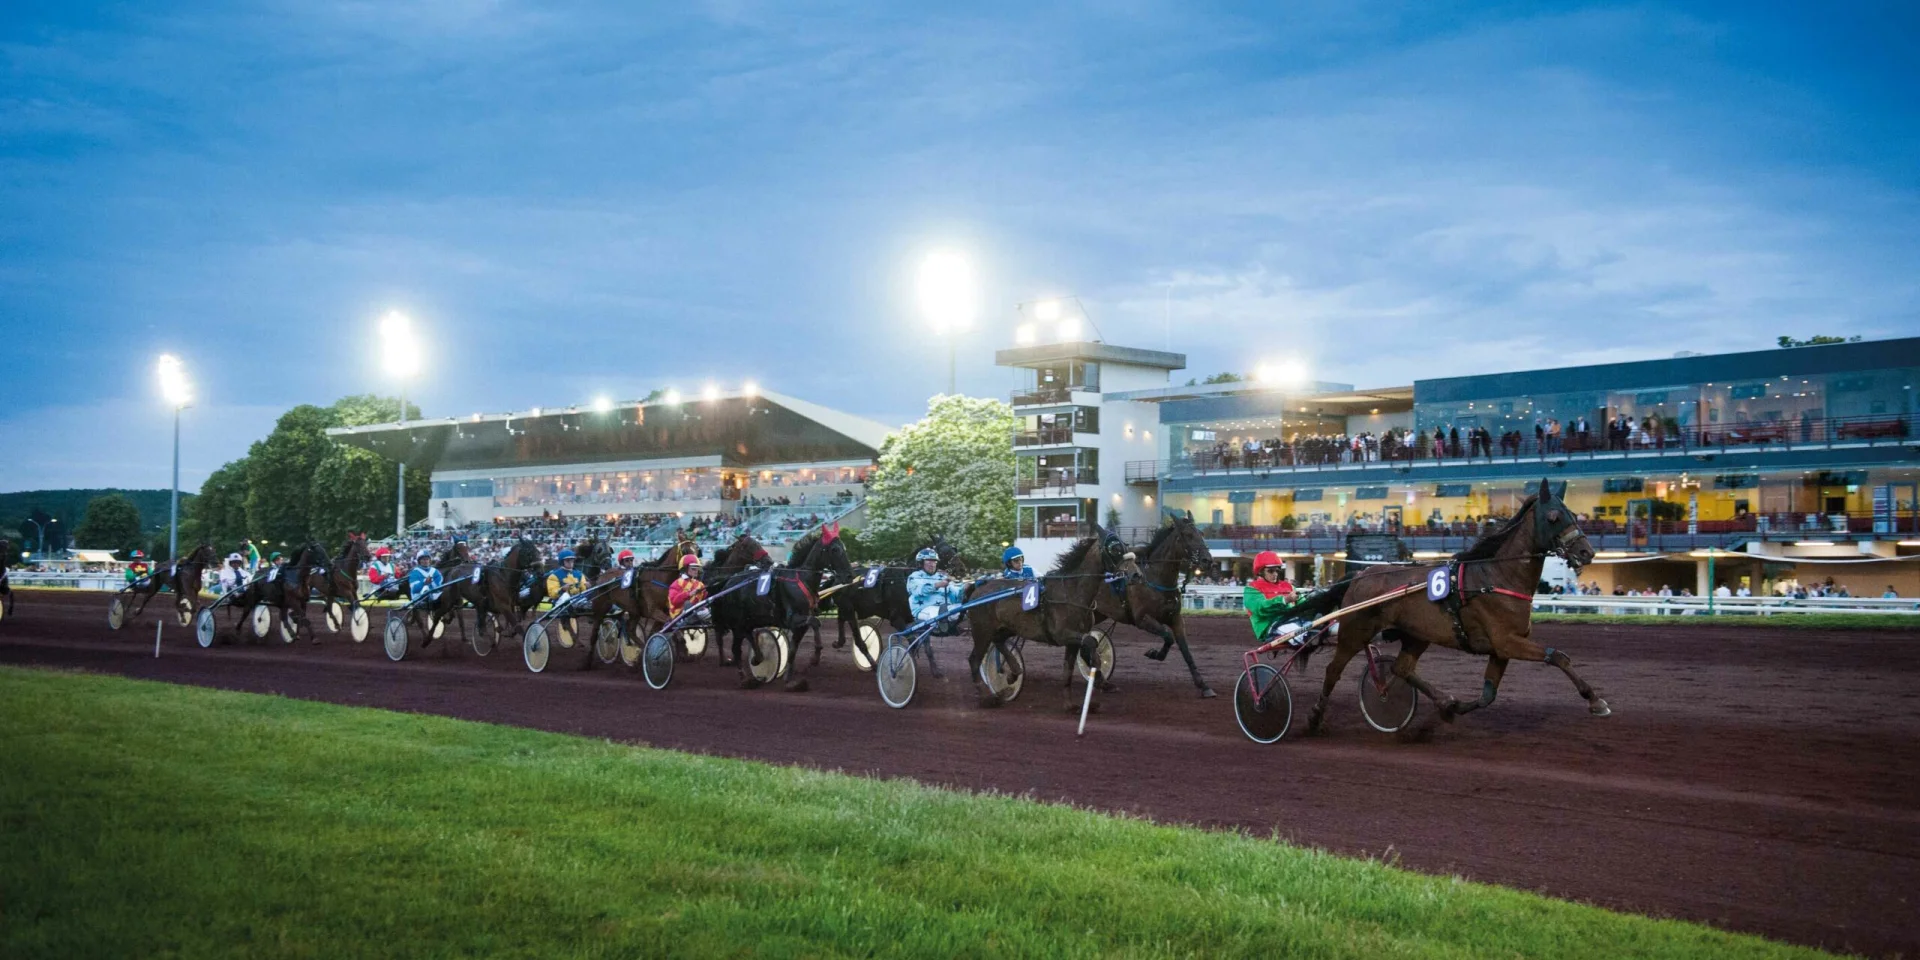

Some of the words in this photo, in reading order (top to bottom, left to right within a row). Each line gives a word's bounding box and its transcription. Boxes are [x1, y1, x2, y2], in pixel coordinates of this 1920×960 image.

[473, 567, 480, 581] 9
[623, 571, 632, 586] 3
[867, 569, 878, 585] 5
[760, 574, 770, 592] 7
[1431, 570, 1446, 597] 6
[1025, 586, 1036, 606] 4
